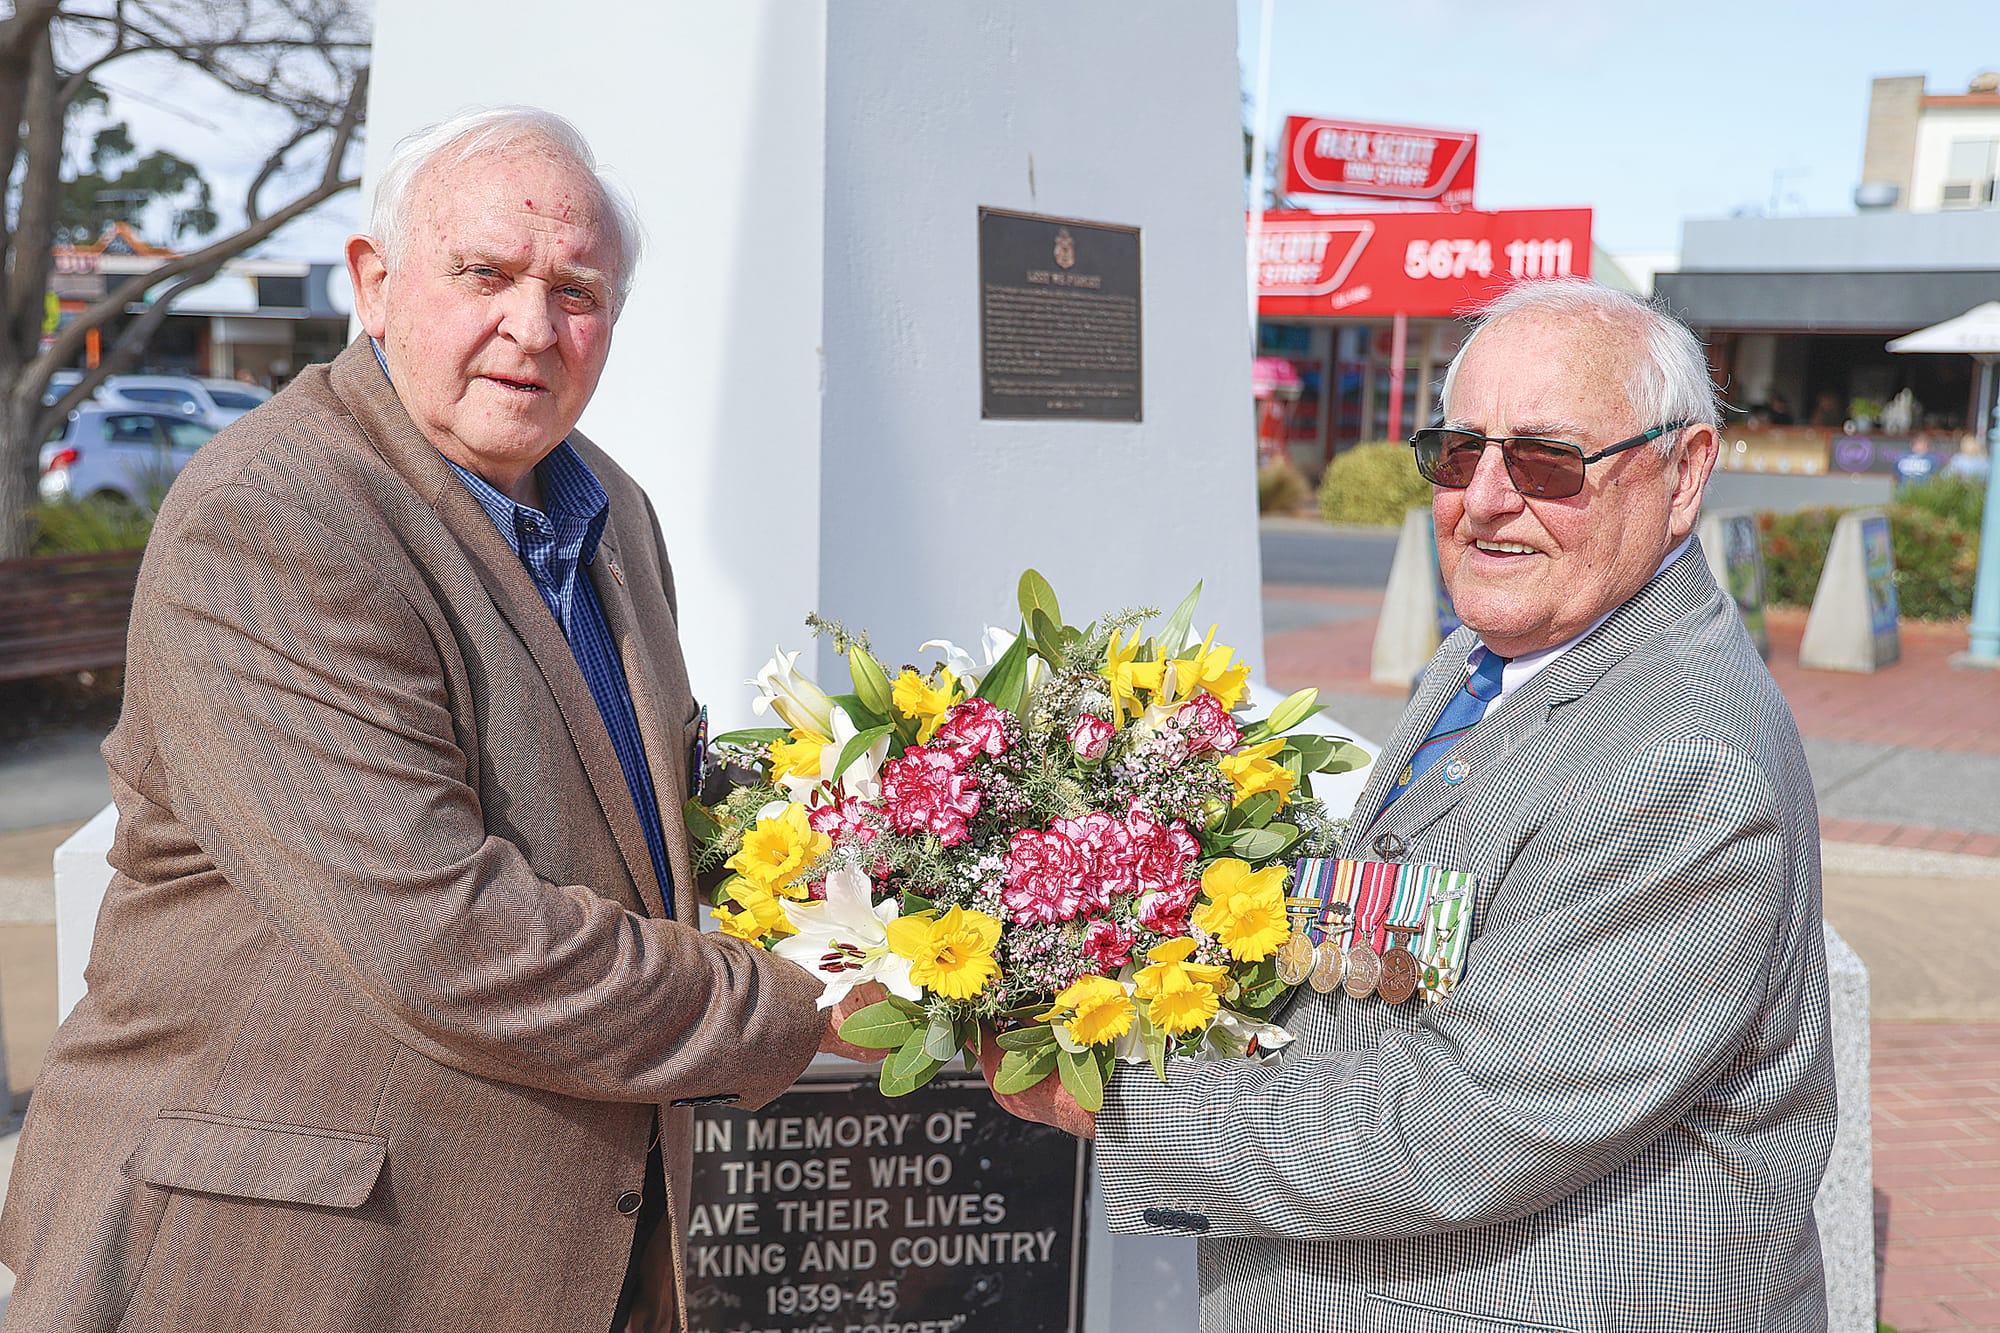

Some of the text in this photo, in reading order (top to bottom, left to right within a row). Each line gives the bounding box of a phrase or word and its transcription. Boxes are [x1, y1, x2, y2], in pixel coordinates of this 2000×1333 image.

[1404, 239, 1494, 279] 5674
[1504, 238, 1573, 278] 1111
[693, 1111, 977, 1154] IN MEMORY OF
[720, 1153, 953, 1195] THOSE WHO
[687, 1193, 1007, 1238] AVE THEIR LIVES
[697, 1231, 1057, 1279] KING AND COUNTRY
[766, 1280, 899, 1316] 1939-45
